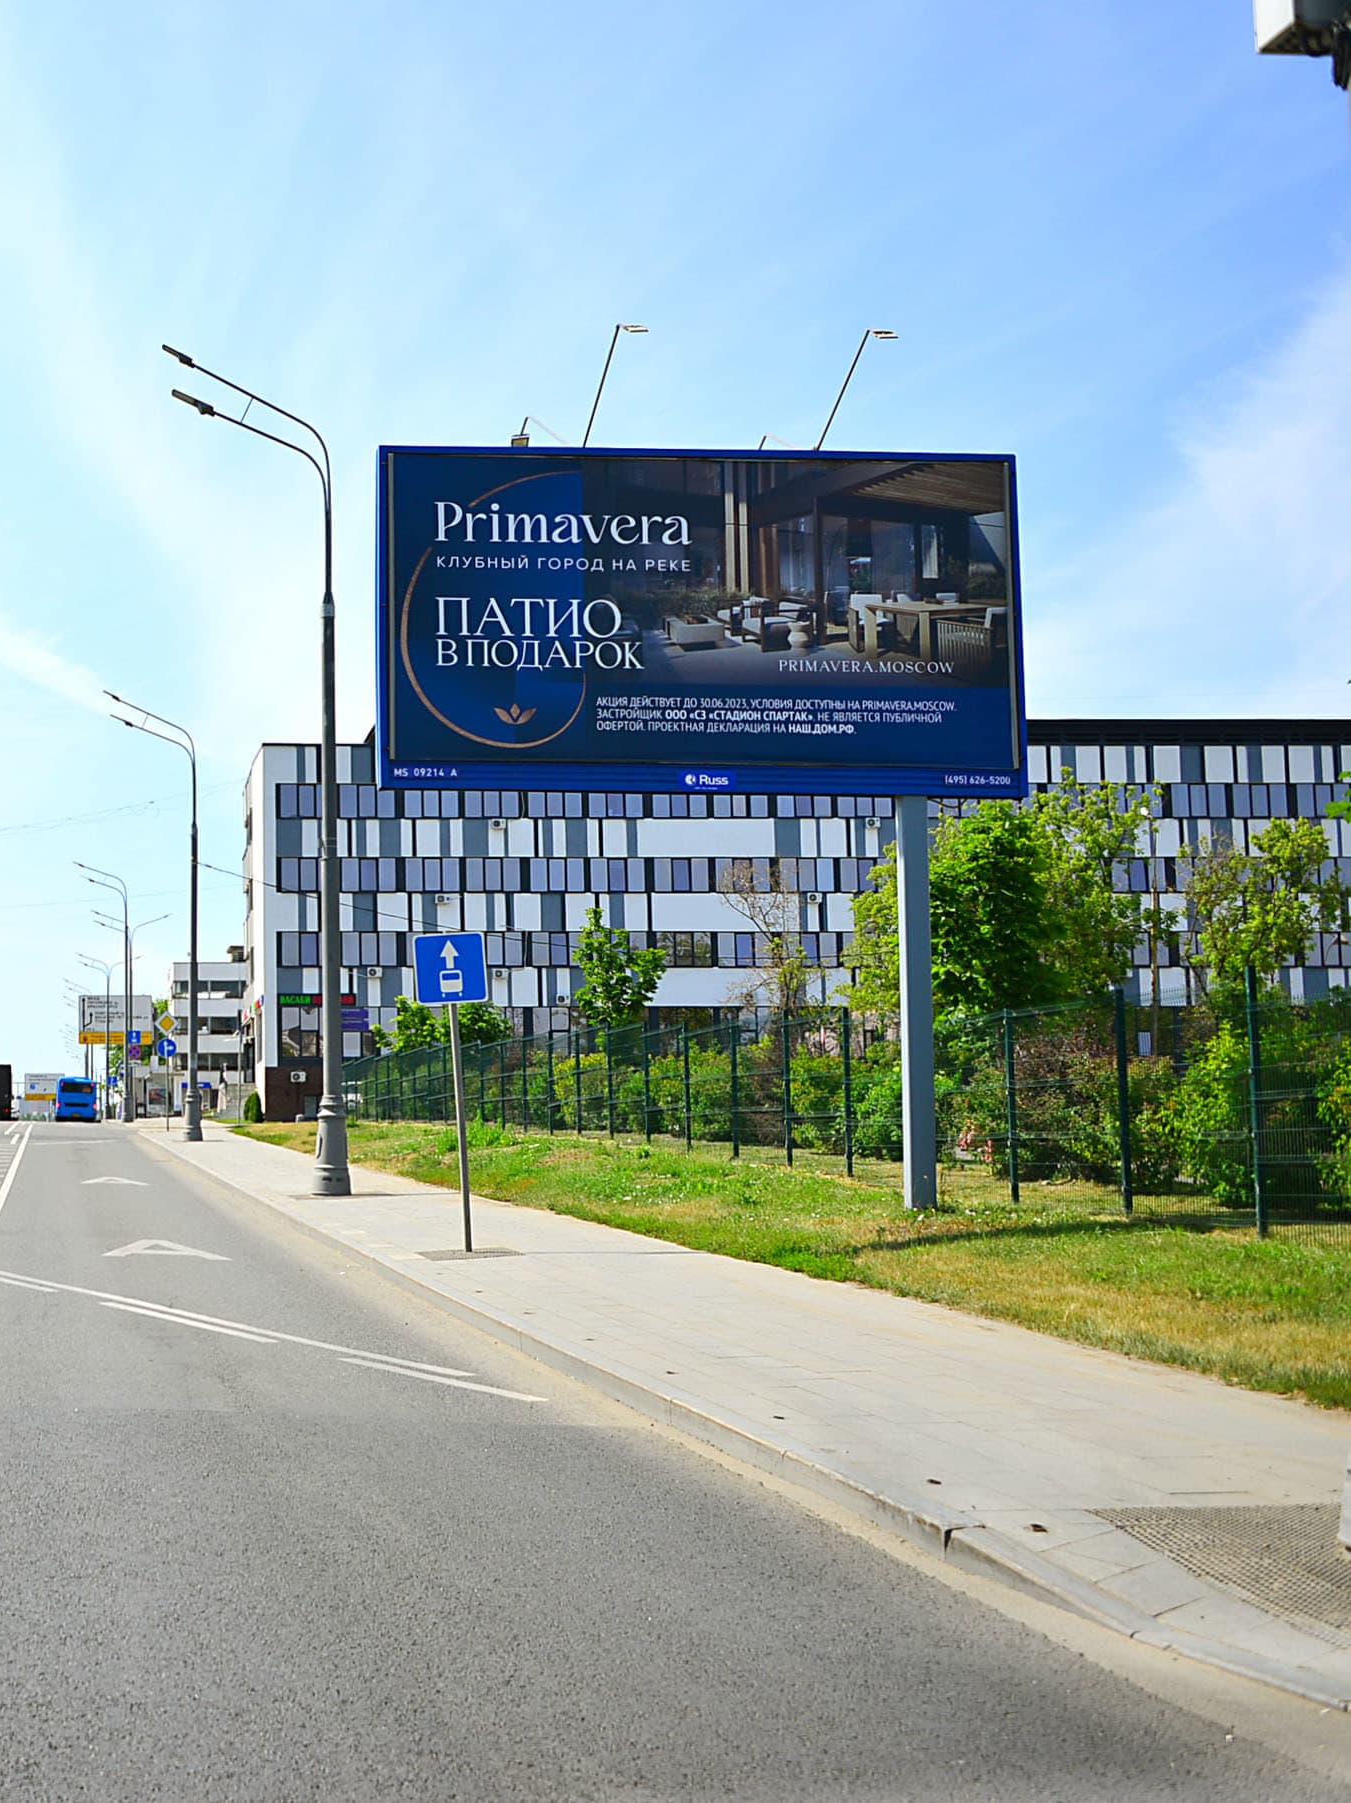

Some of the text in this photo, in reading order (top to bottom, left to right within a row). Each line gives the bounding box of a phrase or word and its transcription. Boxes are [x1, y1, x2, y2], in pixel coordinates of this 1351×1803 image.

[434, 501, 692, 545] Primavera
[436, 554, 691, 572] КЛУБНЫЙ ГОРОД НА РЕКЕ
[435, 597, 622, 638] ПАТИО
[778, 659, 954, 674] PRIMAVERA.MOSCOW
[596, 696, 957, 712] АКЦИЯ ДЕЙСТВУЕТ ДО 30.06.2023, УСЛОВИЯ ДОСТУПНЫ НА PRIMAVERA.MOSCOW.
[596, 708, 663, 720] ЗАСТРОЙЩИК
[665, 710, 687, 720] ООО
[708, 710, 761, 721] «СТАДИОН
[817, 712, 831, 722] НЕ
[832, 712, 880, 723] ЯВЛЯЕТСЯ
[883, 712, 942, 723] ПУБЛИЧНОЙ
[596, 720, 645, 731] ОФЕРТОЙ.
[648, 721, 705, 732] ПРОЕКТНАЯ
[706, 722, 770, 734] ДЕКЛАРАЦИЯ
[773, 724, 786, 733] НА
[394, 768, 458, 777] MS 09214 A
[699, 774, 729, 785] Russ
[944, 774, 1011, 785] (495) 626-5200
